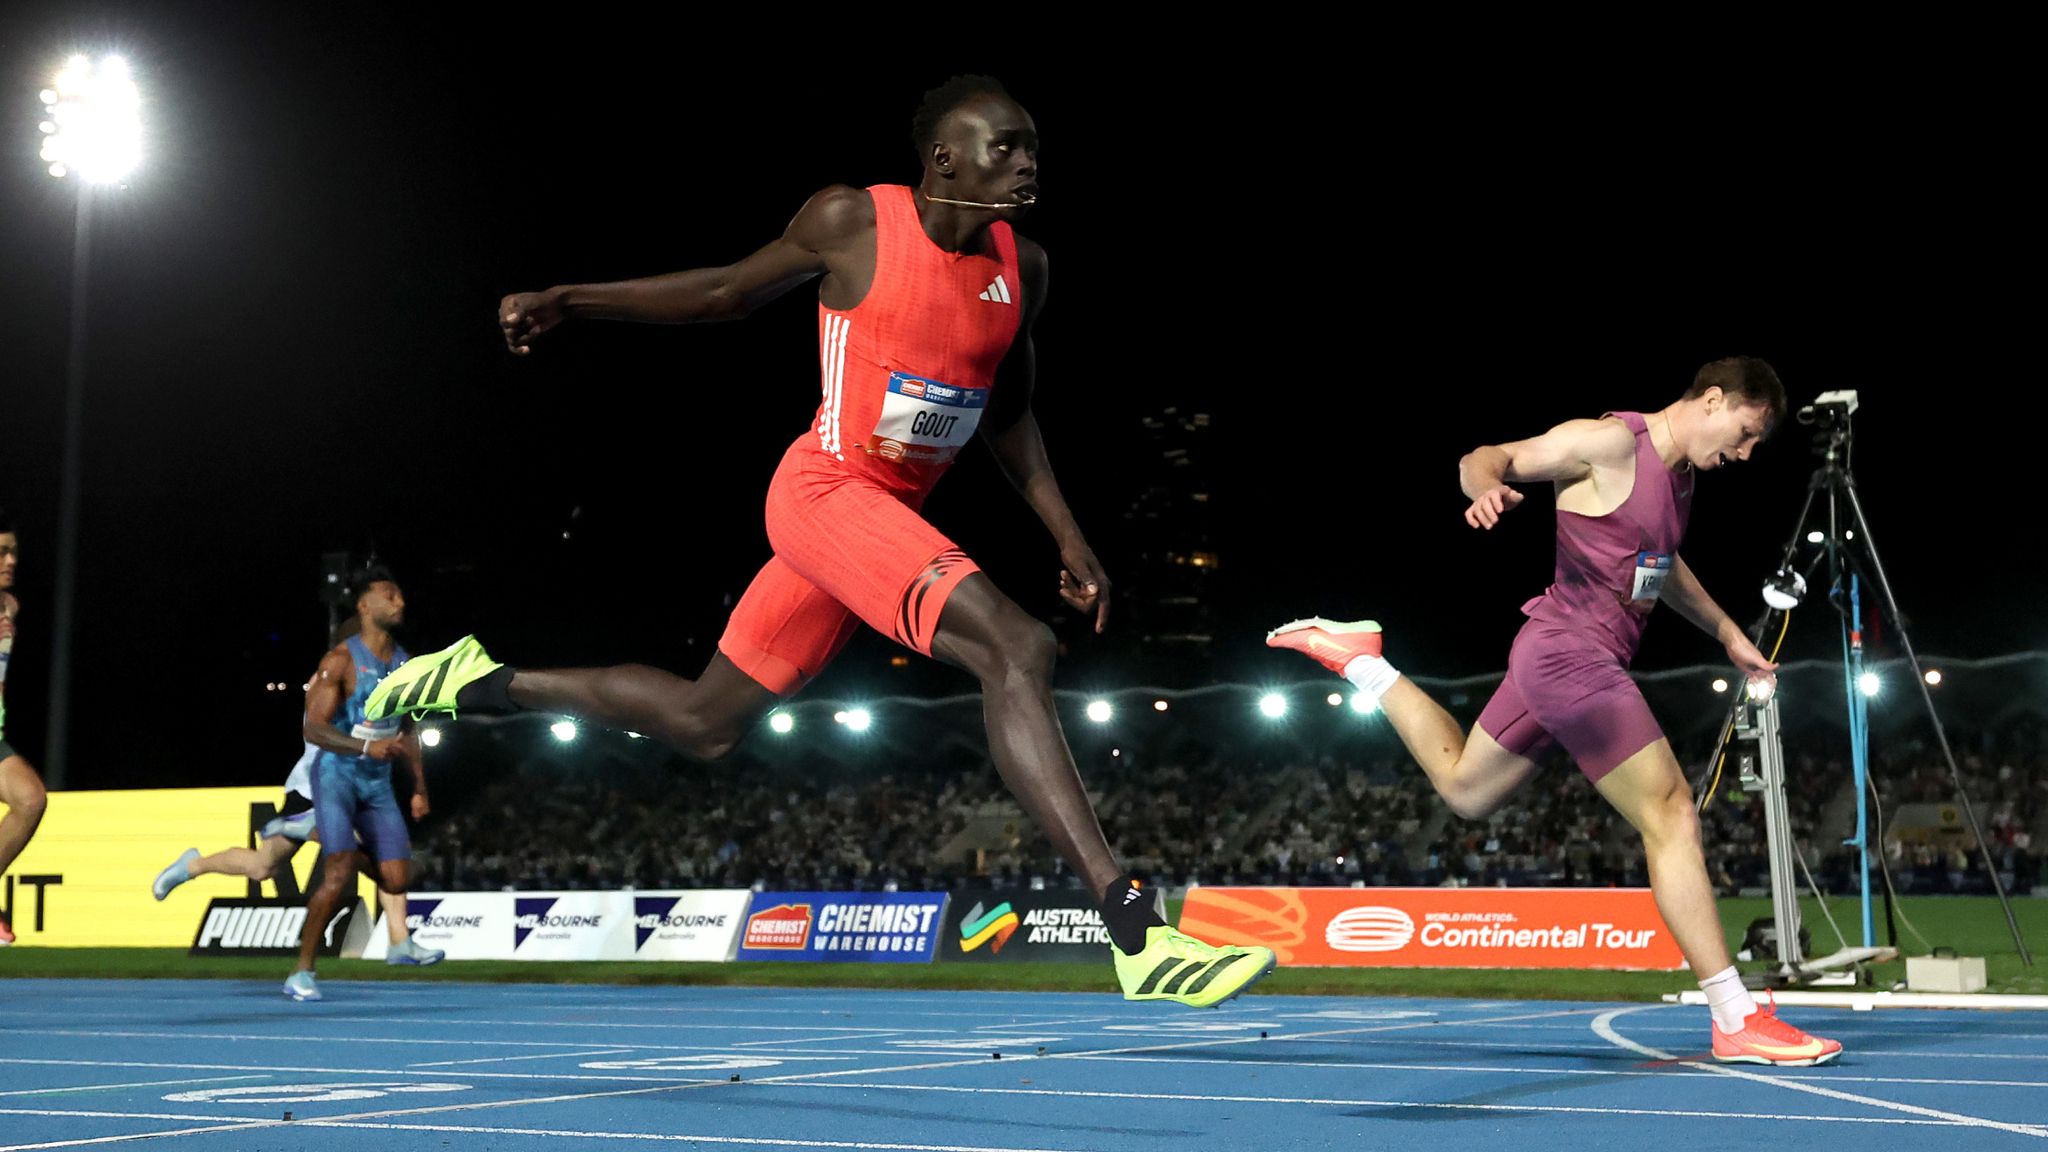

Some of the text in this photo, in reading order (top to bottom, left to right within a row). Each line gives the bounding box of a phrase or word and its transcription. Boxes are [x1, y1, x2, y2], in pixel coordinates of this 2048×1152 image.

[911, 410, 959, 438] GOUT
[406, 914, 484, 928] ELBOURNE
[514, 913, 603, 928] MELBOURNE
[634, 913, 728, 928] MELBOURNE
[818, 903, 939, 934] CHEMIST
[1425, 912, 1460, 922] WORLD
[198, 907, 309, 948] PUMA
[750, 919, 808, 935] CHEMIST
[814, 935, 927, 953] WAREHOUSE
[1420, 922, 1657, 950] Continental Tour
